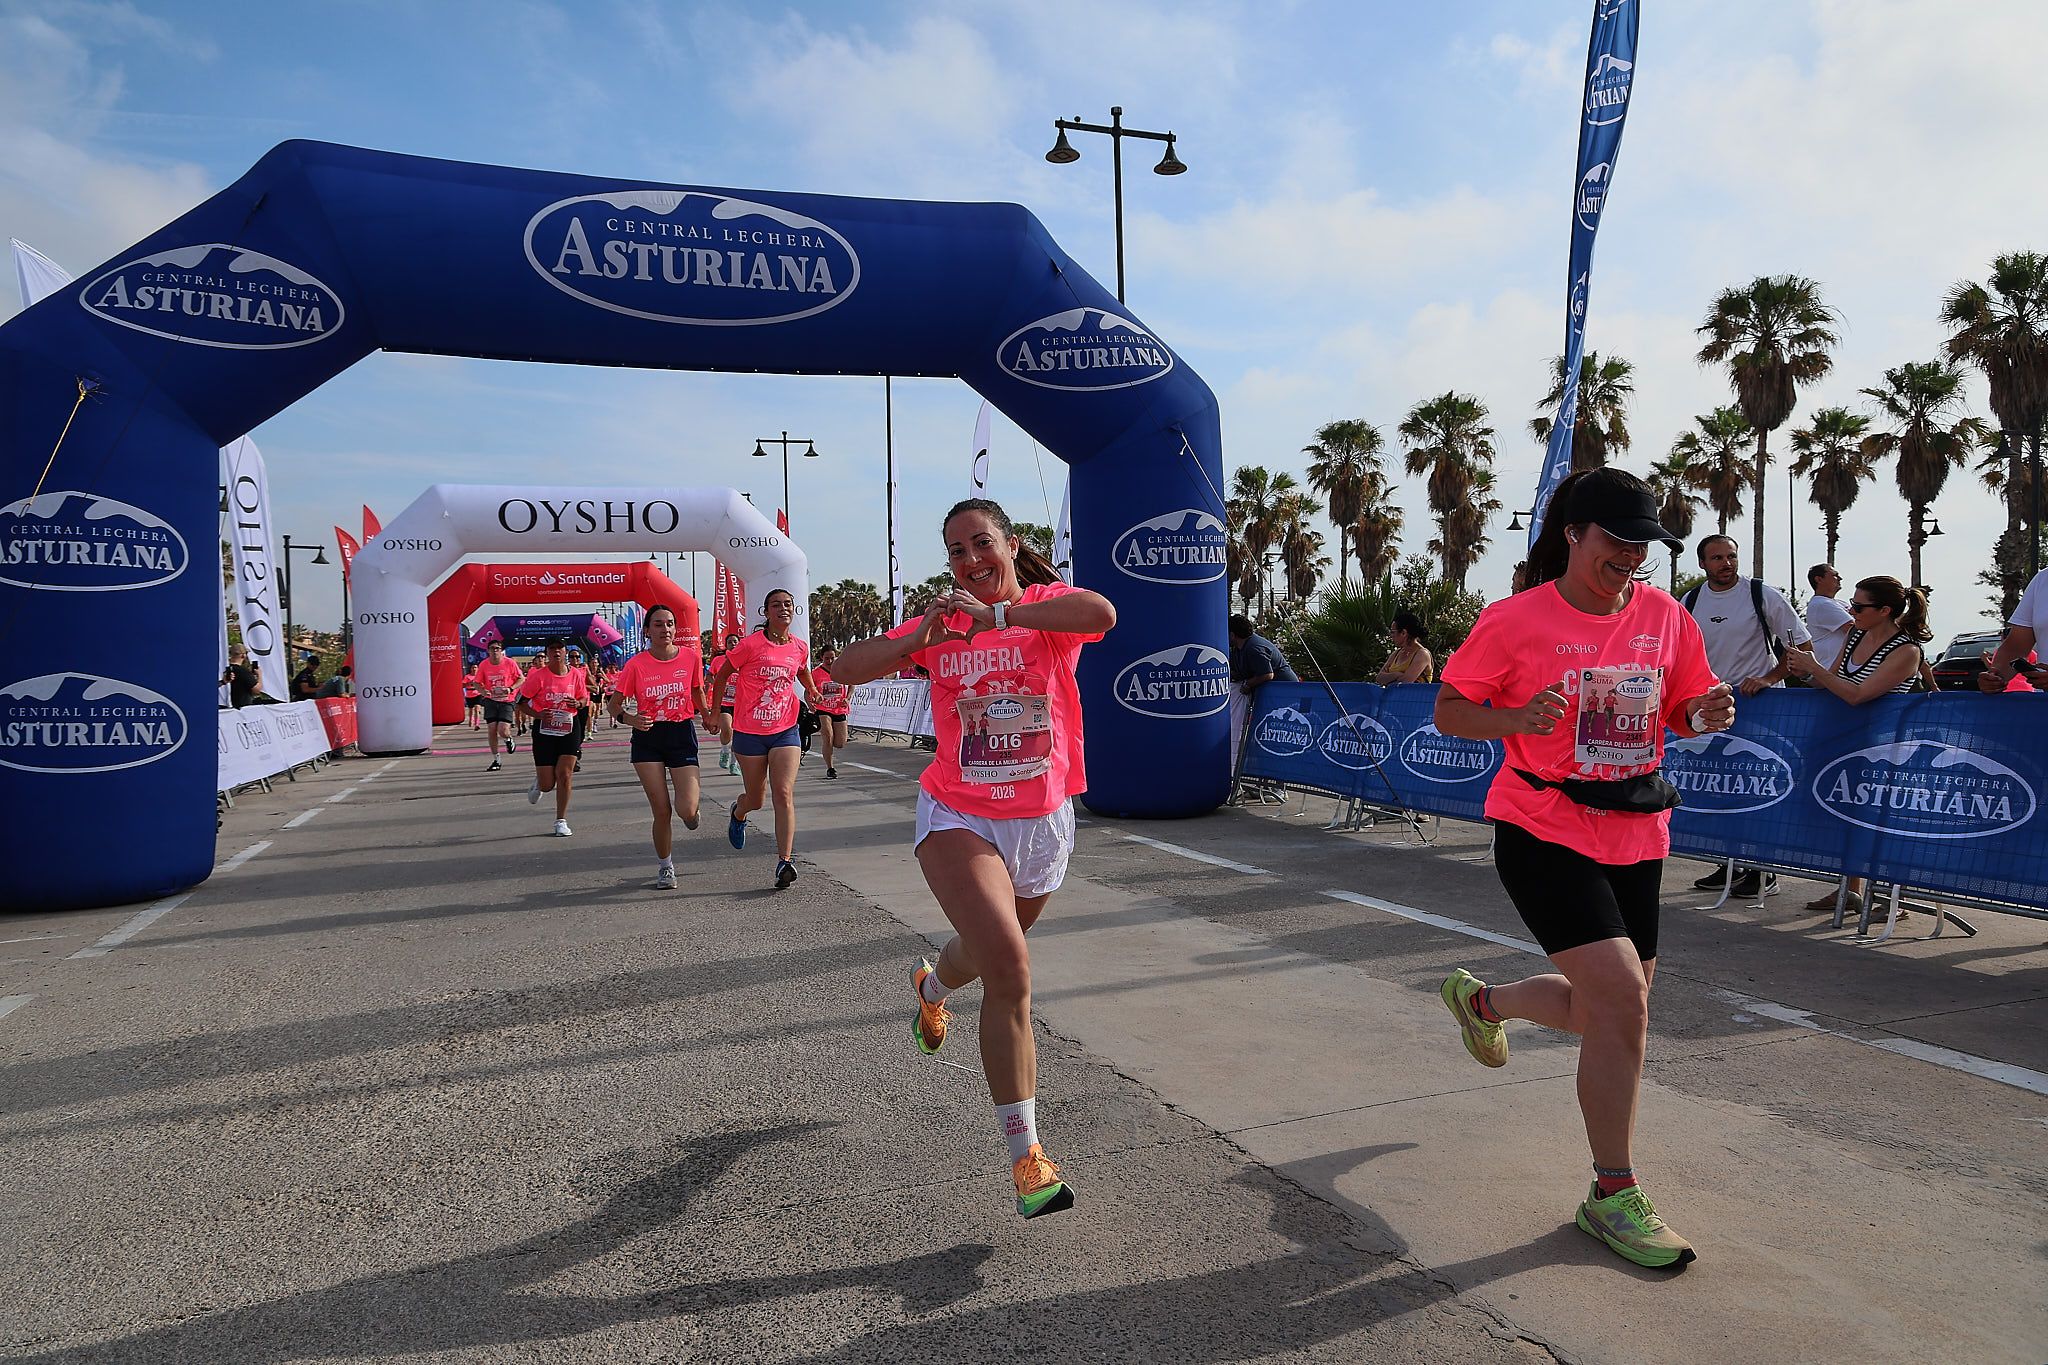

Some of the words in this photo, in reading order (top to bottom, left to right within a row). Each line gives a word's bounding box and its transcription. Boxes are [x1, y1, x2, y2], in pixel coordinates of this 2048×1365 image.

[606, 217, 713, 240] CENTRAL
[723, 228, 826, 249] LECHERA
[552, 217, 837, 294] ASTURIANA
[142, 272, 226, 288] CENTRAL
[236, 280, 321, 302] LECHERA
[95, 275, 324, 332] ASTURIANA
[1042, 335, 1101, 346] CENTRAL
[1012, 341, 1166, 371] ASTURIANA
[498, 498, 680, 534] OYSHO
[10, 525, 83, 536] CENTRAL
[92, 527, 168, 542] LECHERA
[1148, 535, 1196, 544] CENTRAL
[383, 539, 442, 551] OYSHO
[729, 537, 779, 548] OYSHO
[0, 539, 175, 571] STURIANA
[494, 573, 537, 588] Sports
[558, 572, 626, 585] Santander
[360, 612, 415, 625] OYSHO
[1556, 643, 1598, 655] OYSHO
[939, 646, 1026, 678] CARRERA
[1149, 670, 1197, 679] CENTRAL
[362, 685, 417, 699] OYSHO
[646, 682, 685, 698] CARRERA
[879, 687, 909, 708] OYSHO
[667, 696, 679, 710] DE
[8, 707, 81, 717] CENTRAL
[90, 707, 168, 717] LECHERA
[752, 706, 782, 720] MUJER
[1615, 714, 1649, 731] 016
[0, 721, 174, 747] STURIANA
[989, 733, 1022, 749] 016
[1322, 731, 1384, 758] ASTURIANA
[1405, 740, 1485, 769] ASTURIANA
[1672, 759, 1720, 769] CENTRAL
[1725, 762, 1777, 772] LECHERA
[1666, 769, 1779, 796] STURIANA
[1861, 768, 1927, 784] CENTRAL
[1934, 775, 2011, 791] LECHERA
[990, 785, 1015, 800] 2026
[1826, 769, 2014, 822] ASTURIANA
[1006, 1120, 1024, 1128] BAD
[1006, 1126, 1028, 1136] VIBES
